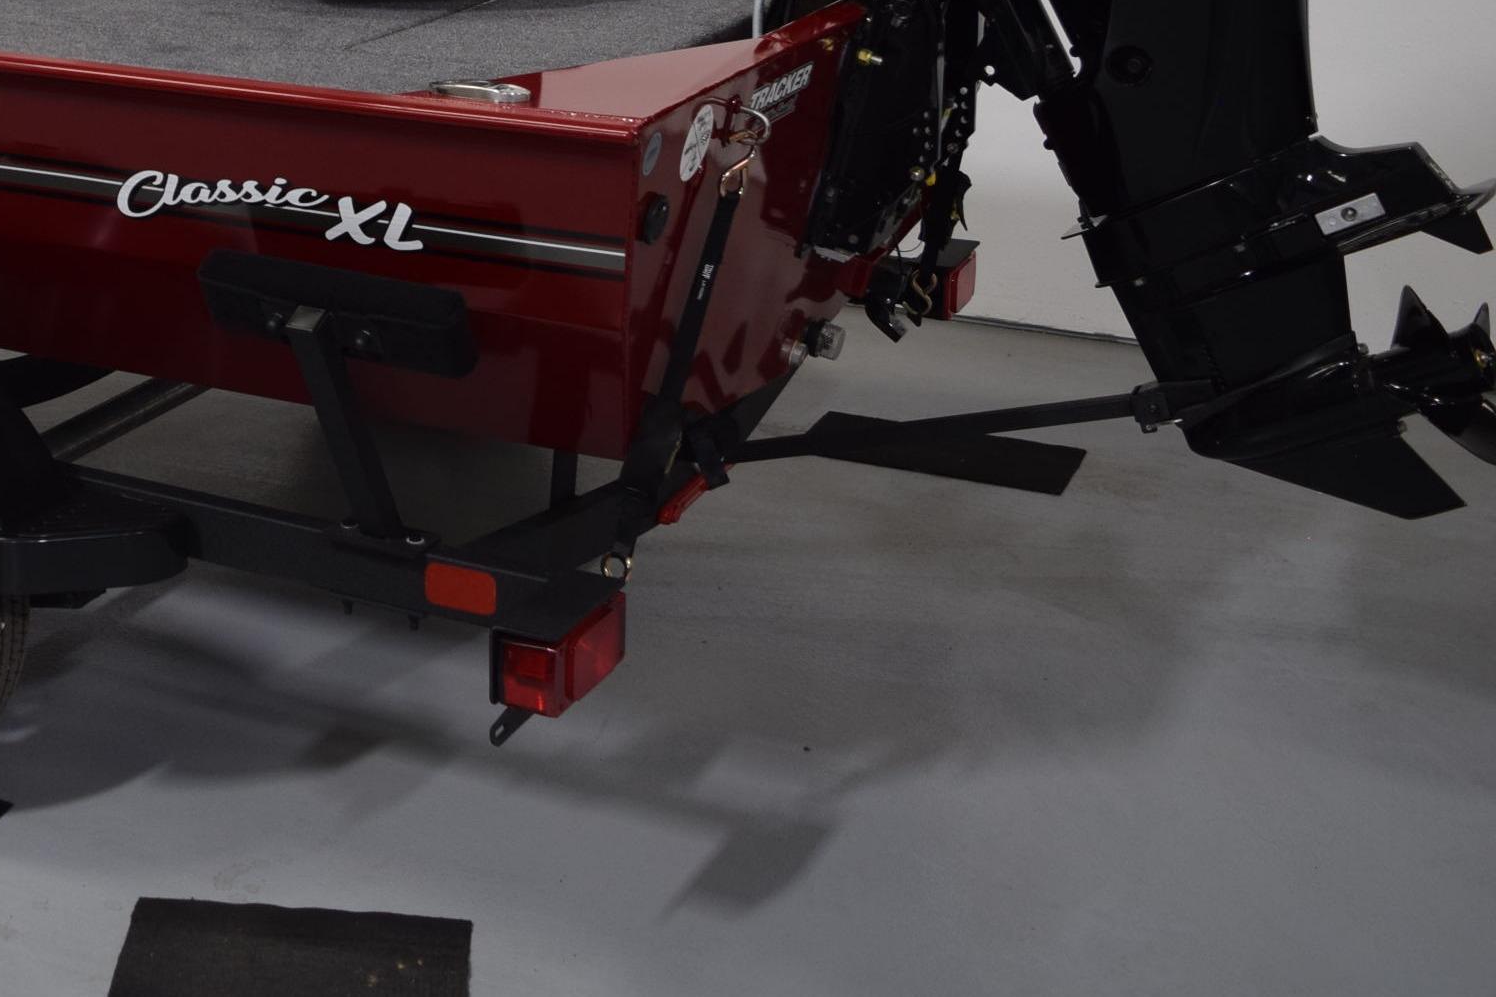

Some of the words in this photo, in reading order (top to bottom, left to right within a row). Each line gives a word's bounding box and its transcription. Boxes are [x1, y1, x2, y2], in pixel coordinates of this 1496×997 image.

[750, 63, 814, 110] TRACKER
[116, 169, 330, 218] Classic
[324, 195, 424, 251] XL
